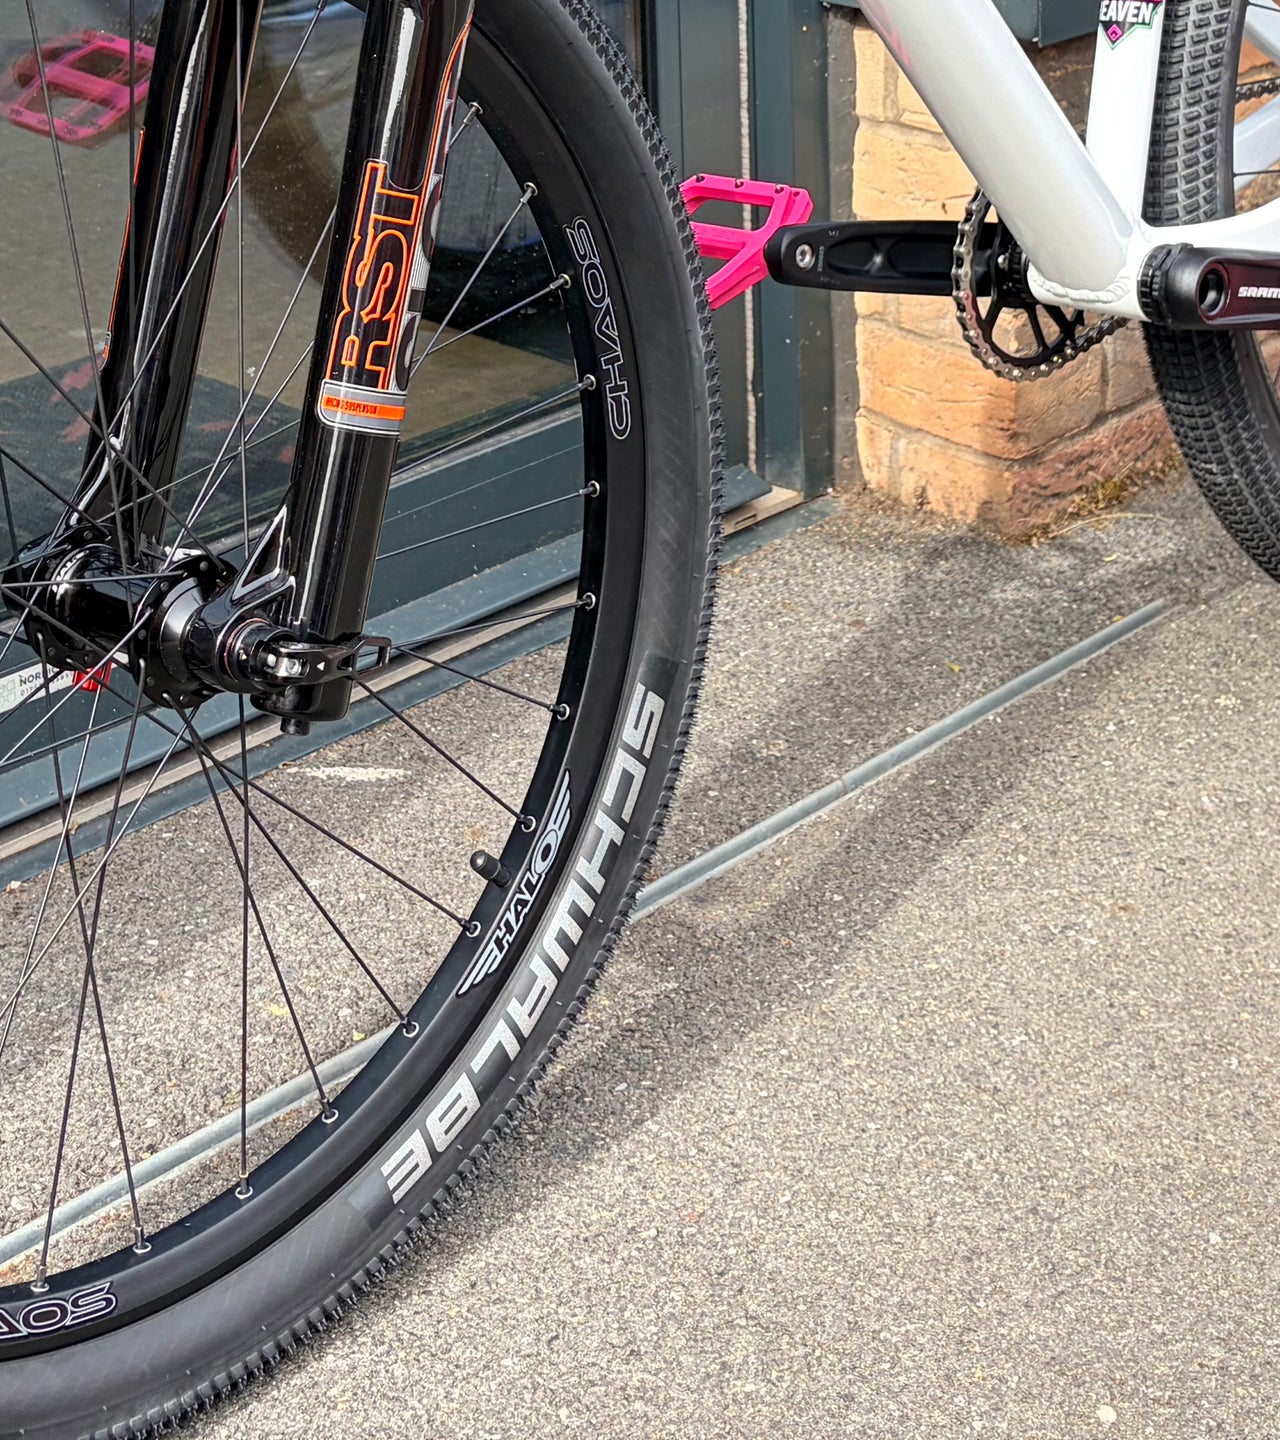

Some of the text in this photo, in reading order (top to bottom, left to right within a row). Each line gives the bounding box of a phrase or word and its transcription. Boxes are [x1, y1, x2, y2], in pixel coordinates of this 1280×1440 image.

[1100, 0, 1153, 23] EAVEN
[325, 162, 419, 390] RST
[564, 213, 633, 441] CHAOS
[380, 681, 665, 1206] SCHWALBE
